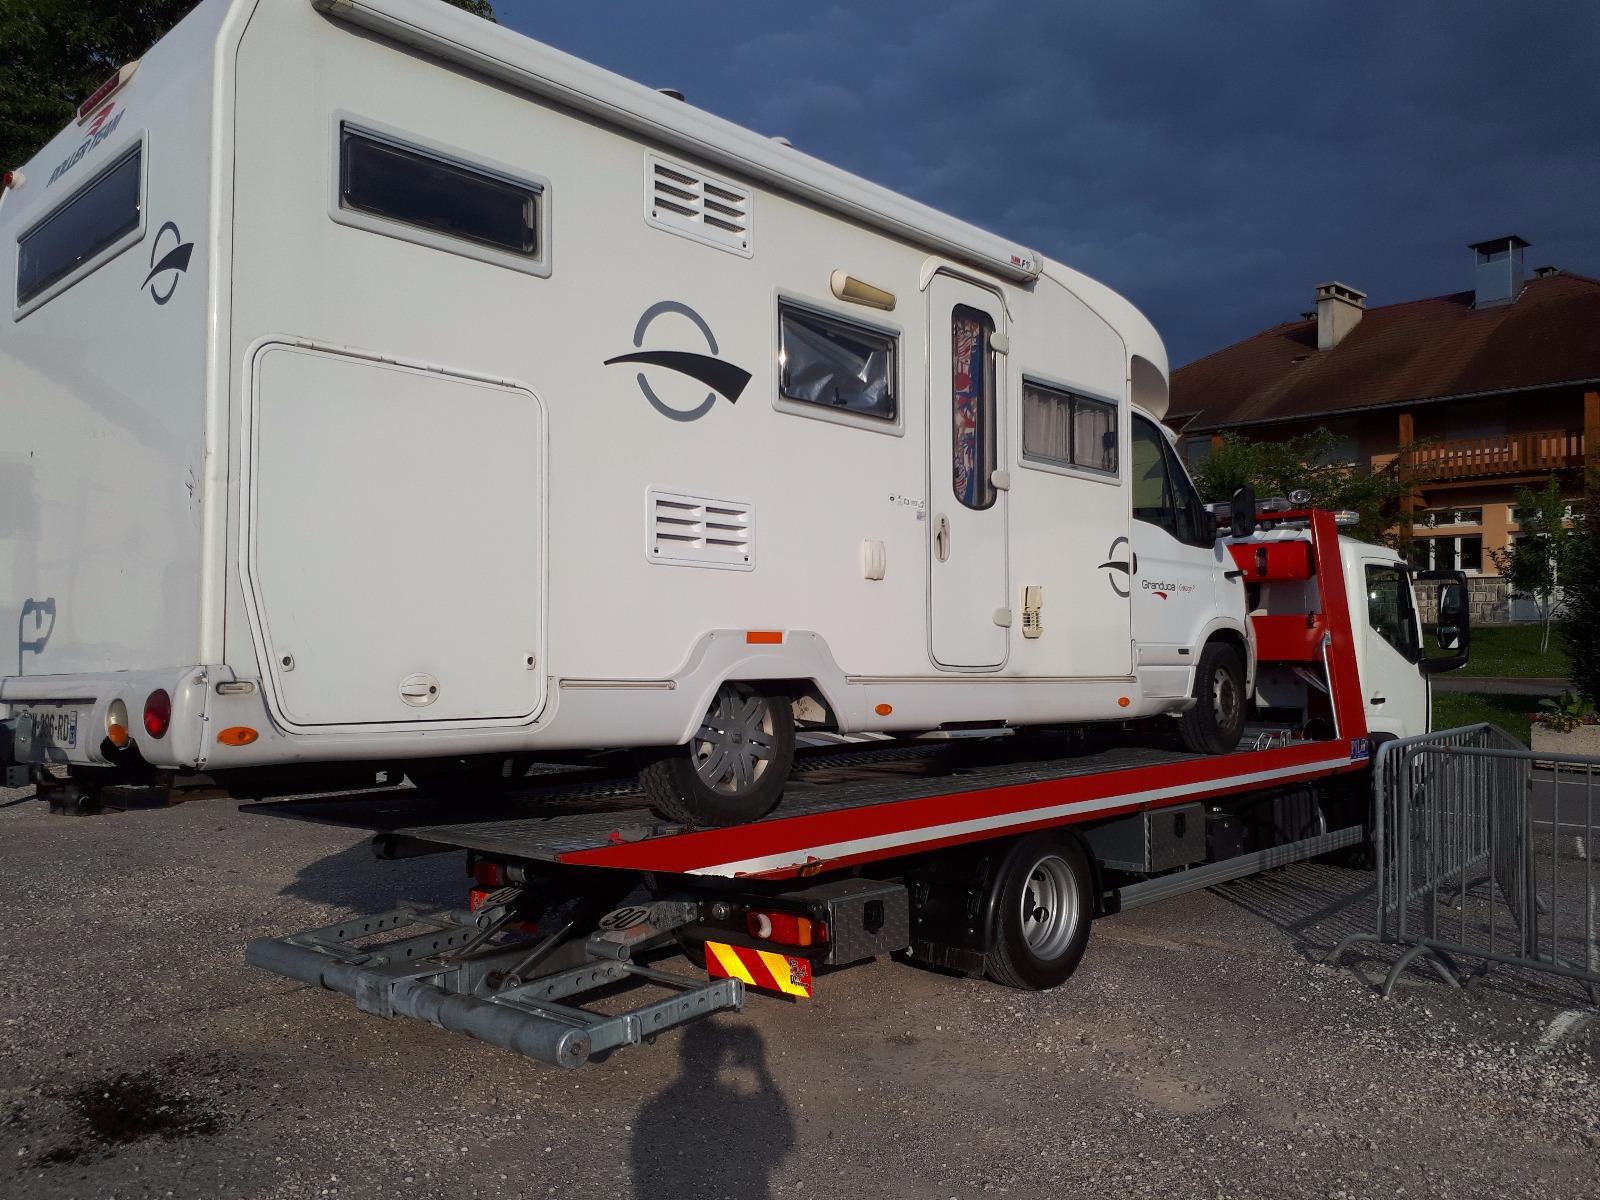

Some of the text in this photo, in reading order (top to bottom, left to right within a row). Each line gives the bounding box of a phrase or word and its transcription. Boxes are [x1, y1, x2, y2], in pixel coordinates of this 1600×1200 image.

[46, 107, 126, 188] ROLLER TEAM
[1141, 579, 1176, 591] Granduca
[601, 907, 647, 929] 90
